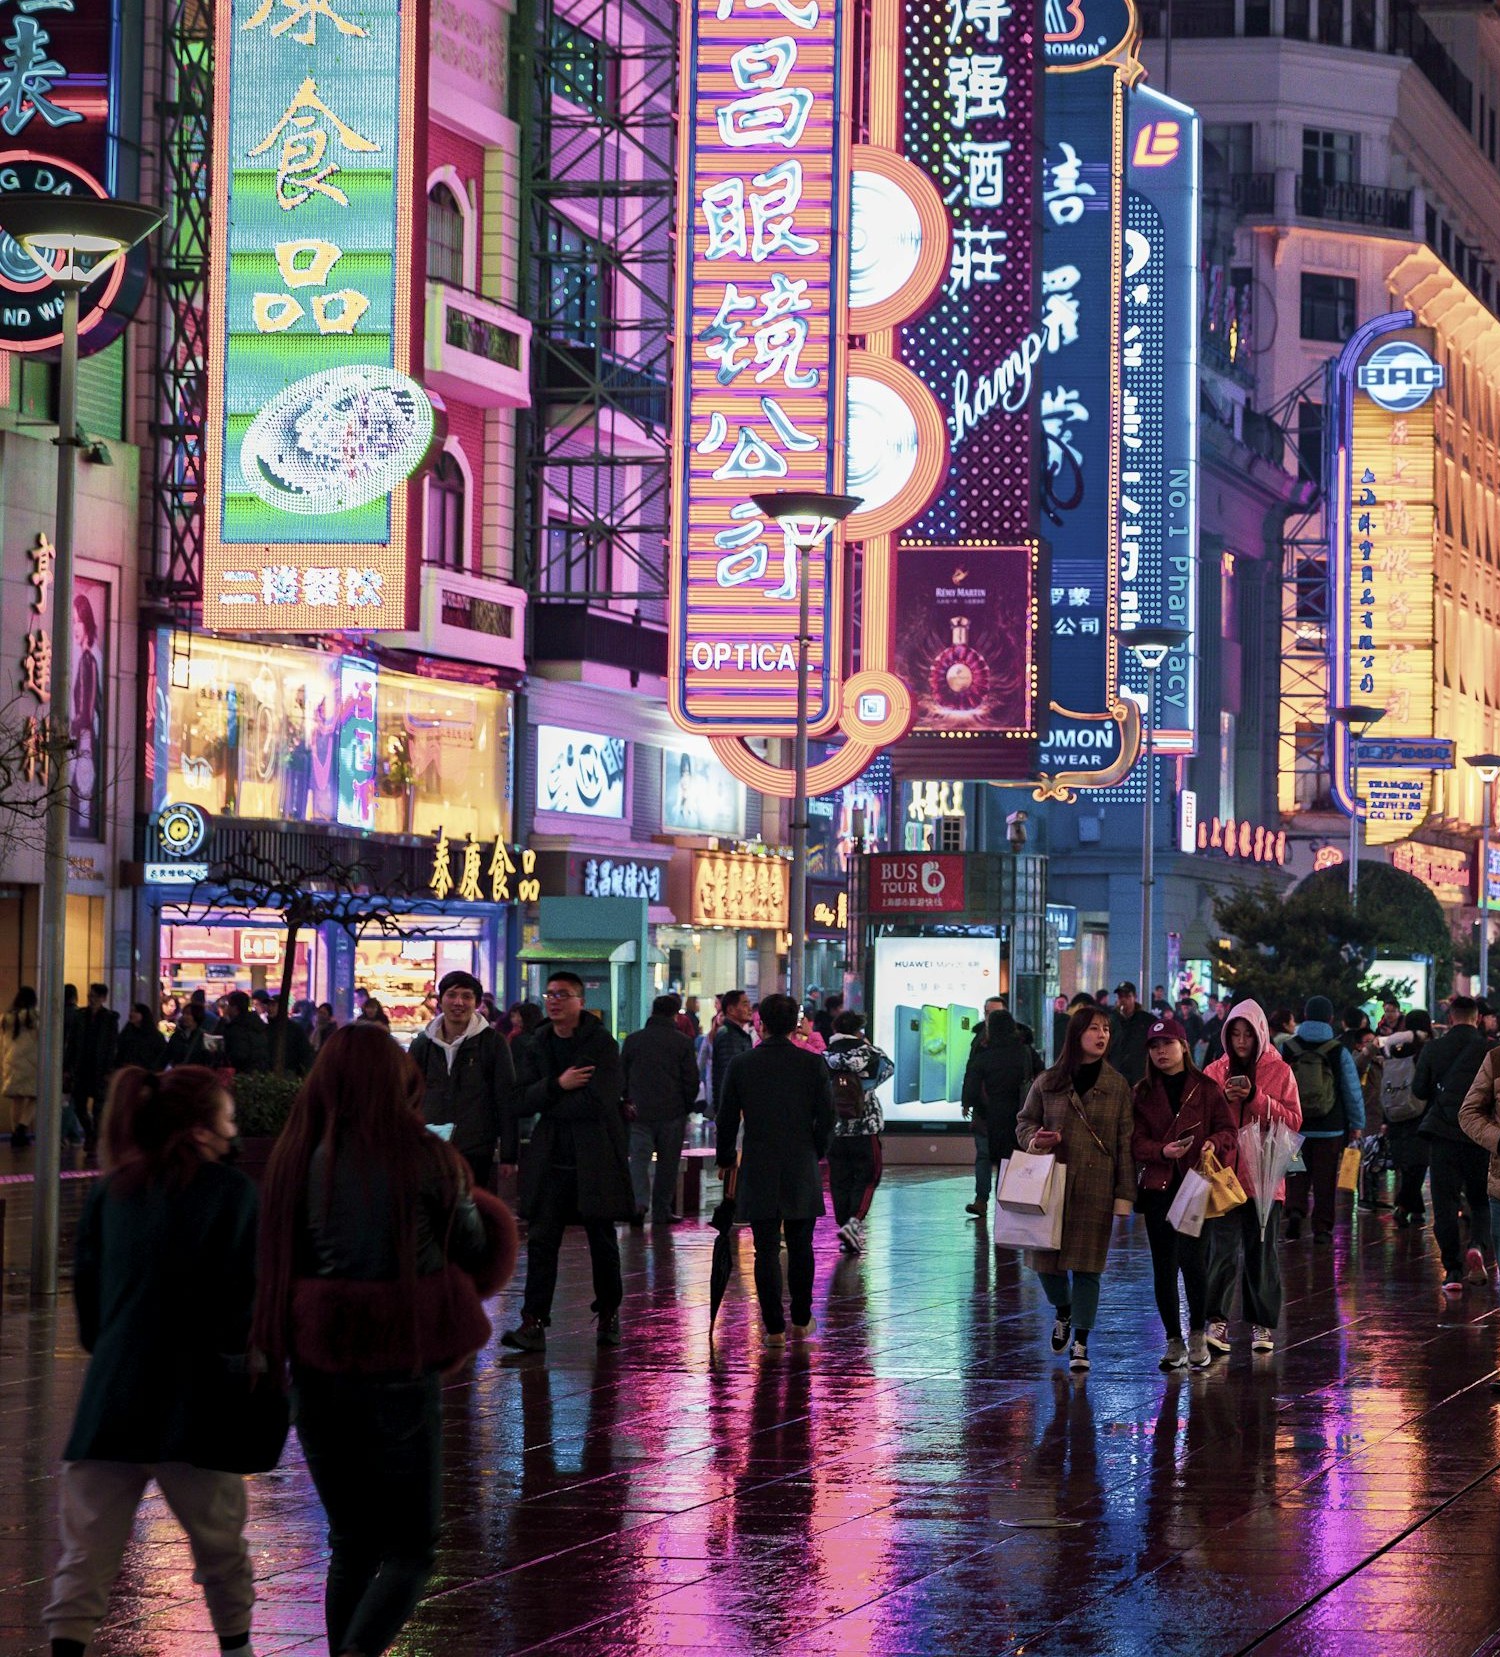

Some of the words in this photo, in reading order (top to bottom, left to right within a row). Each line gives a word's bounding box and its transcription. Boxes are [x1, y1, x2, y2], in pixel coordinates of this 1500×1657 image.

[1044, 43, 1099, 56] ROMON
[0, 0, 83, 136] 表
[696, 0, 820, 600] 昌眼镜公司
[1361, 367, 1440, 386] BAC
[218, 566, 383, 607] 二楼餐饮
[1055, 617, 1099, 635] 公司
[1164, 556, 1189, 708] Pharacy
[429, 830, 540, 902] 泰康食品
[881, 864, 917, 879] BUS
[881, 882, 917, 894] TOUR
[894, 960, 933, 968] HUAWEI
